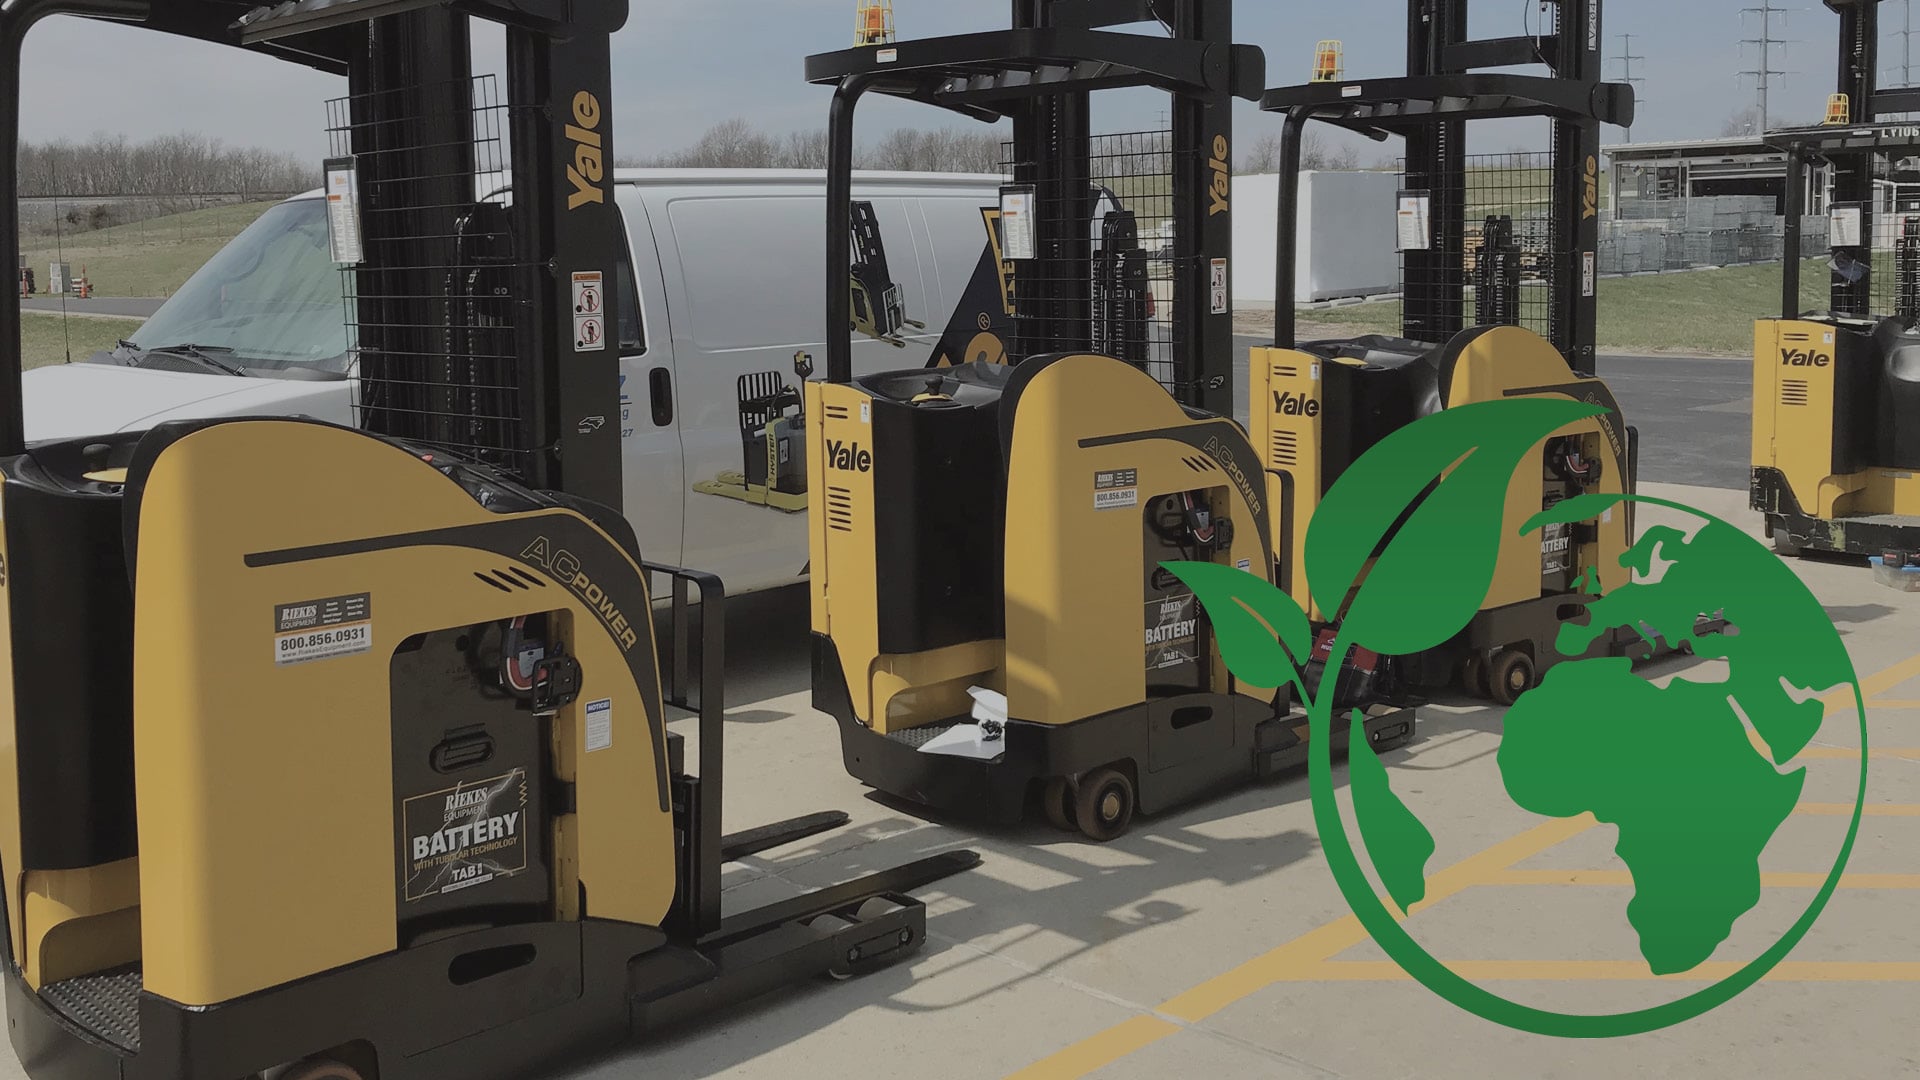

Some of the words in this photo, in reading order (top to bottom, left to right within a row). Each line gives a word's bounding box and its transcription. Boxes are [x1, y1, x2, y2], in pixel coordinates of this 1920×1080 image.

[564, 90, 604, 211] Yale
[1209, 134, 1228, 216] Yale
[1583, 155, 1596, 219] Yale
[1781, 348, 1830, 367] Yale
[1273, 390, 1320, 417] Yale
[826, 439, 871, 472] Yale
[280, 617, 317, 629] EQUIPMENT
[281, 604, 318, 621] RIEKES
[281, 627, 365, 651] 800.856.0931
[1145, 619, 1196, 645] BATTERY
[444, 787, 489, 811] RIEKES
[444, 803, 488, 822] EQUIPMENT
[413, 811, 519, 860] BATTERY
[413, 859, 434, 872] WITH
[470, 836, 518, 857] TECHNOLOGY
